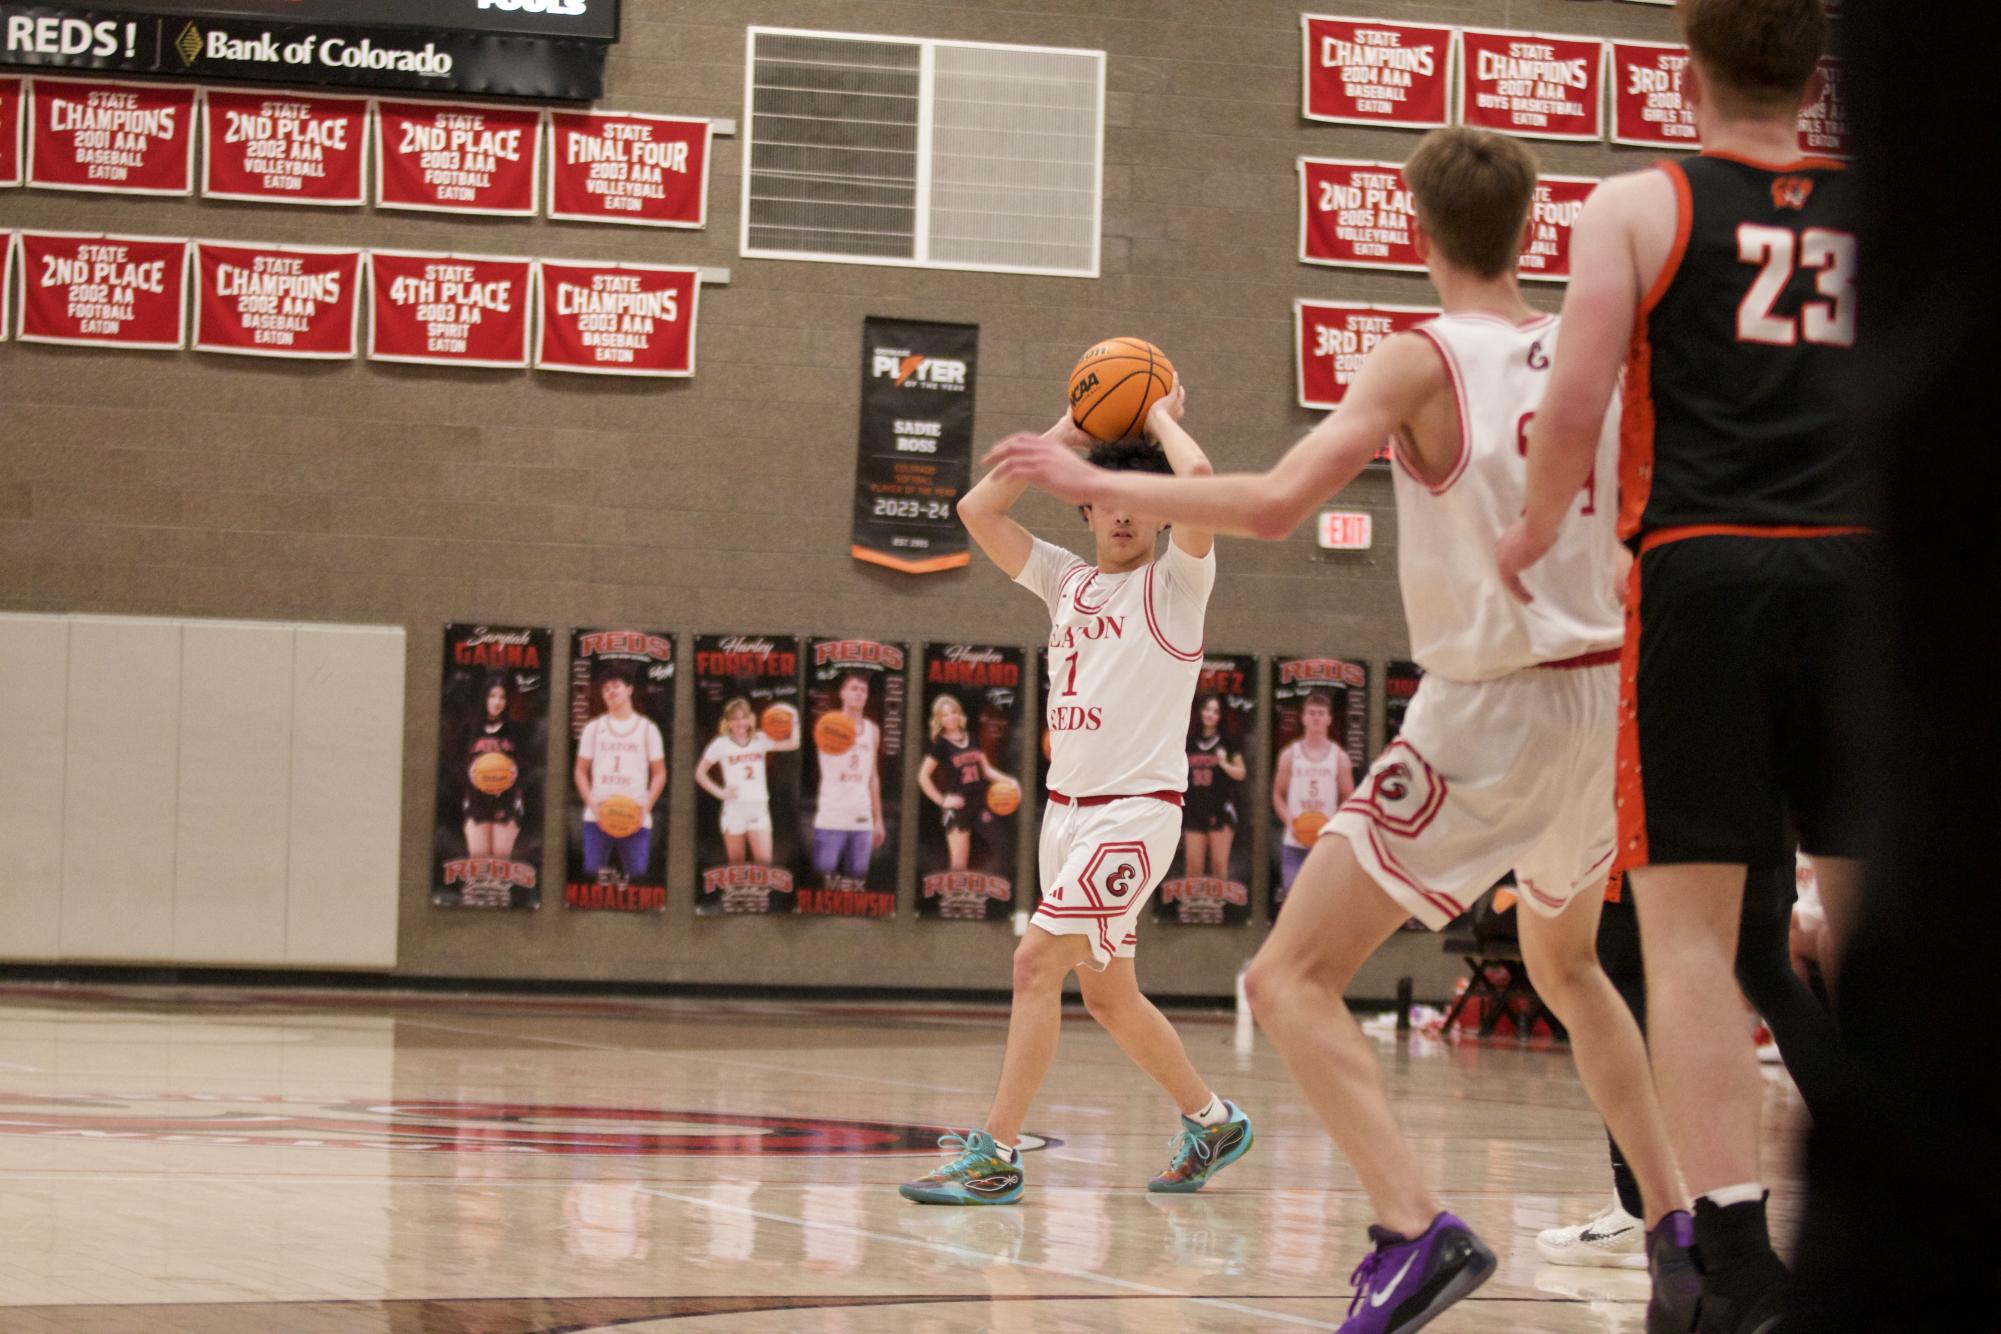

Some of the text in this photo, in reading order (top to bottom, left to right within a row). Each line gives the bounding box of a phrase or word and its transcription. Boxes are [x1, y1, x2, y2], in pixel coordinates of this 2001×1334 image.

[1353, 28, 1401, 47] STATE
[206, 31, 453, 74] Bank of Colorado
[1321, 36, 1434, 77] CHAMPIONS
[1508, 42, 1555, 60] STATE
[1381, 68, 1412, 87] AAA
[1478, 48, 1587, 90] CHAMPIONS
[1627, 63, 1668, 95] 3RD
[87, 91, 139, 109] STATE
[1345, 83, 1407, 101] BASEBALL
[1536, 81, 1566, 100] AAA
[261, 102, 312, 119] STATE
[1356, 98, 1393, 114] EATON
[1511, 97, 1585, 116] BASKETBALL
[1642, 106, 1678, 123] GIRLS
[51, 98, 176, 140] CHAMPIONS
[435, 112, 485, 131] STATE
[1512, 112, 1547, 127] EATON
[224, 110, 348, 150] 2ND PLACE
[603, 123, 653, 141] STATE
[1662, 123, 1697, 138] EATON
[74, 130, 147, 151] 2001 AAA
[399, 121, 521, 161] 2ND PLACE
[76, 149, 144, 167] BASEBALL
[246, 140, 323, 161] 2002 AAA
[567, 132, 688, 173] FINAL FOUR
[243, 159, 326, 177] VOLLEYBALL
[420, 151, 496, 172] 2003 AAA
[88, 165, 128, 180] EATON
[424, 169, 491, 187] FOOTBALL
[590, 163, 662, 183] 2003 AAA
[1350, 172, 1397, 190] STATE
[263, 175, 302, 190] EATON
[586, 180, 666, 198] VOLLEYBALL
[437, 186, 476, 201] EATON
[1318, 181, 1417, 216] 2ND PLAC
[604, 197, 642, 211] EATON
[1378, 211, 1408, 229] AAA
[1336, 227, 1410, 245] VOLLEYBALL
[77, 245, 129, 263] STATE
[40, 254, 165, 294] 2ND PLACE
[253, 256, 304, 274] STATE
[425, 264, 475, 282] STATE
[216, 263, 341, 304] CHAMPIONS
[592, 275, 641, 292] STATE
[1736, 222, 1856, 347] 23
[68, 284, 135, 305] 2002 AA
[389, 275, 511, 312] 4TH PLACE
[557, 282, 678, 322] CHAMPIONS
[67, 303, 135, 320] FOOTBALL
[237, 295, 316, 316] 2002 AAA
[416, 303, 481, 324] 2003 AA
[80, 320, 121, 334] EATON
[241, 313, 309, 331] BASEBALL
[427, 322, 470, 338] SPIRIT
[578, 314, 654, 334] 2003 AAA
[1346, 315, 1393, 333] STATE
[254, 330, 294, 345] EATON
[427, 338, 466, 353] EATON
[582, 331, 649, 349] BASEBALL
[1314, 323, 1358, 357] 3RD
[595, 347, 634, 363] EATON
[873, 354, 967, 385] PLYER
[893, 420, 942, 436] SADIE
[896, 437, 938, 453] ROSS
[874, 499, 950, 519] 2023-24
[1329, 515, 1366, 545] EXIT
[1050, 616, 1127, 649] EAON
[580, 632, 671, 661] REDS
[815, 640, 904, 670] REDS
[1061, 651, 1079, 697] 1
[1280, 658, 1365, 687] REDS
[443, 859, 536, 889] REDS
[703, 865, 793, 893] REDS
[924, 872, 1011, 900] REDS
[1161, 876, 1248, 906] REDS
